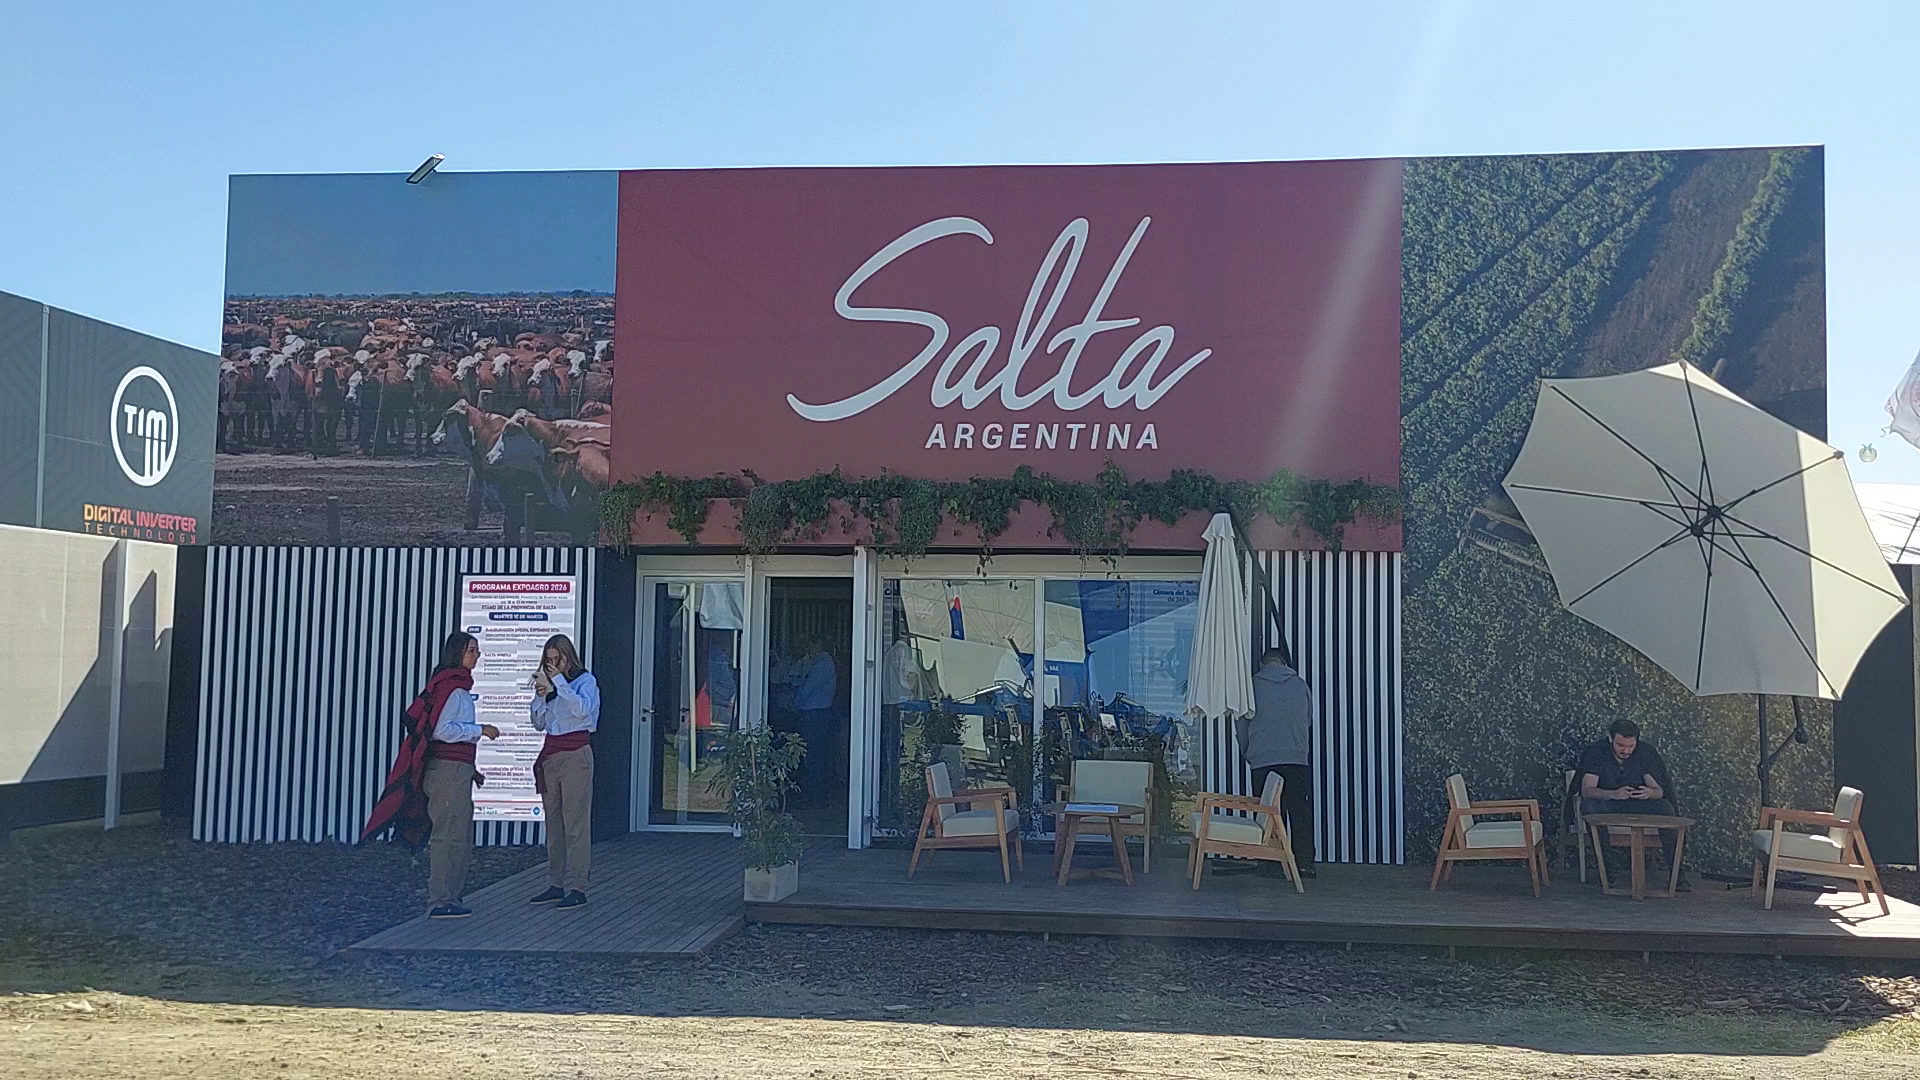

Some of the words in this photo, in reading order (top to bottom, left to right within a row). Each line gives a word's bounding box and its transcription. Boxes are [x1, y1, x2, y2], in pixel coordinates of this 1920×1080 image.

[787, 216, 1212, 422] Salta
[924, 422, 1159, 450] ARGENTINA
[83, 503, 135, 526] DIGITAL
[136, 510, 197, 533] INVERTER
[84, 521, 197, 545] TECHNOLOGY
[472, 583, 512, 591] PROGRAMA
[512, 583, 550, 591] EXPOAGRO
[550, 583, 568, 591] 2026
